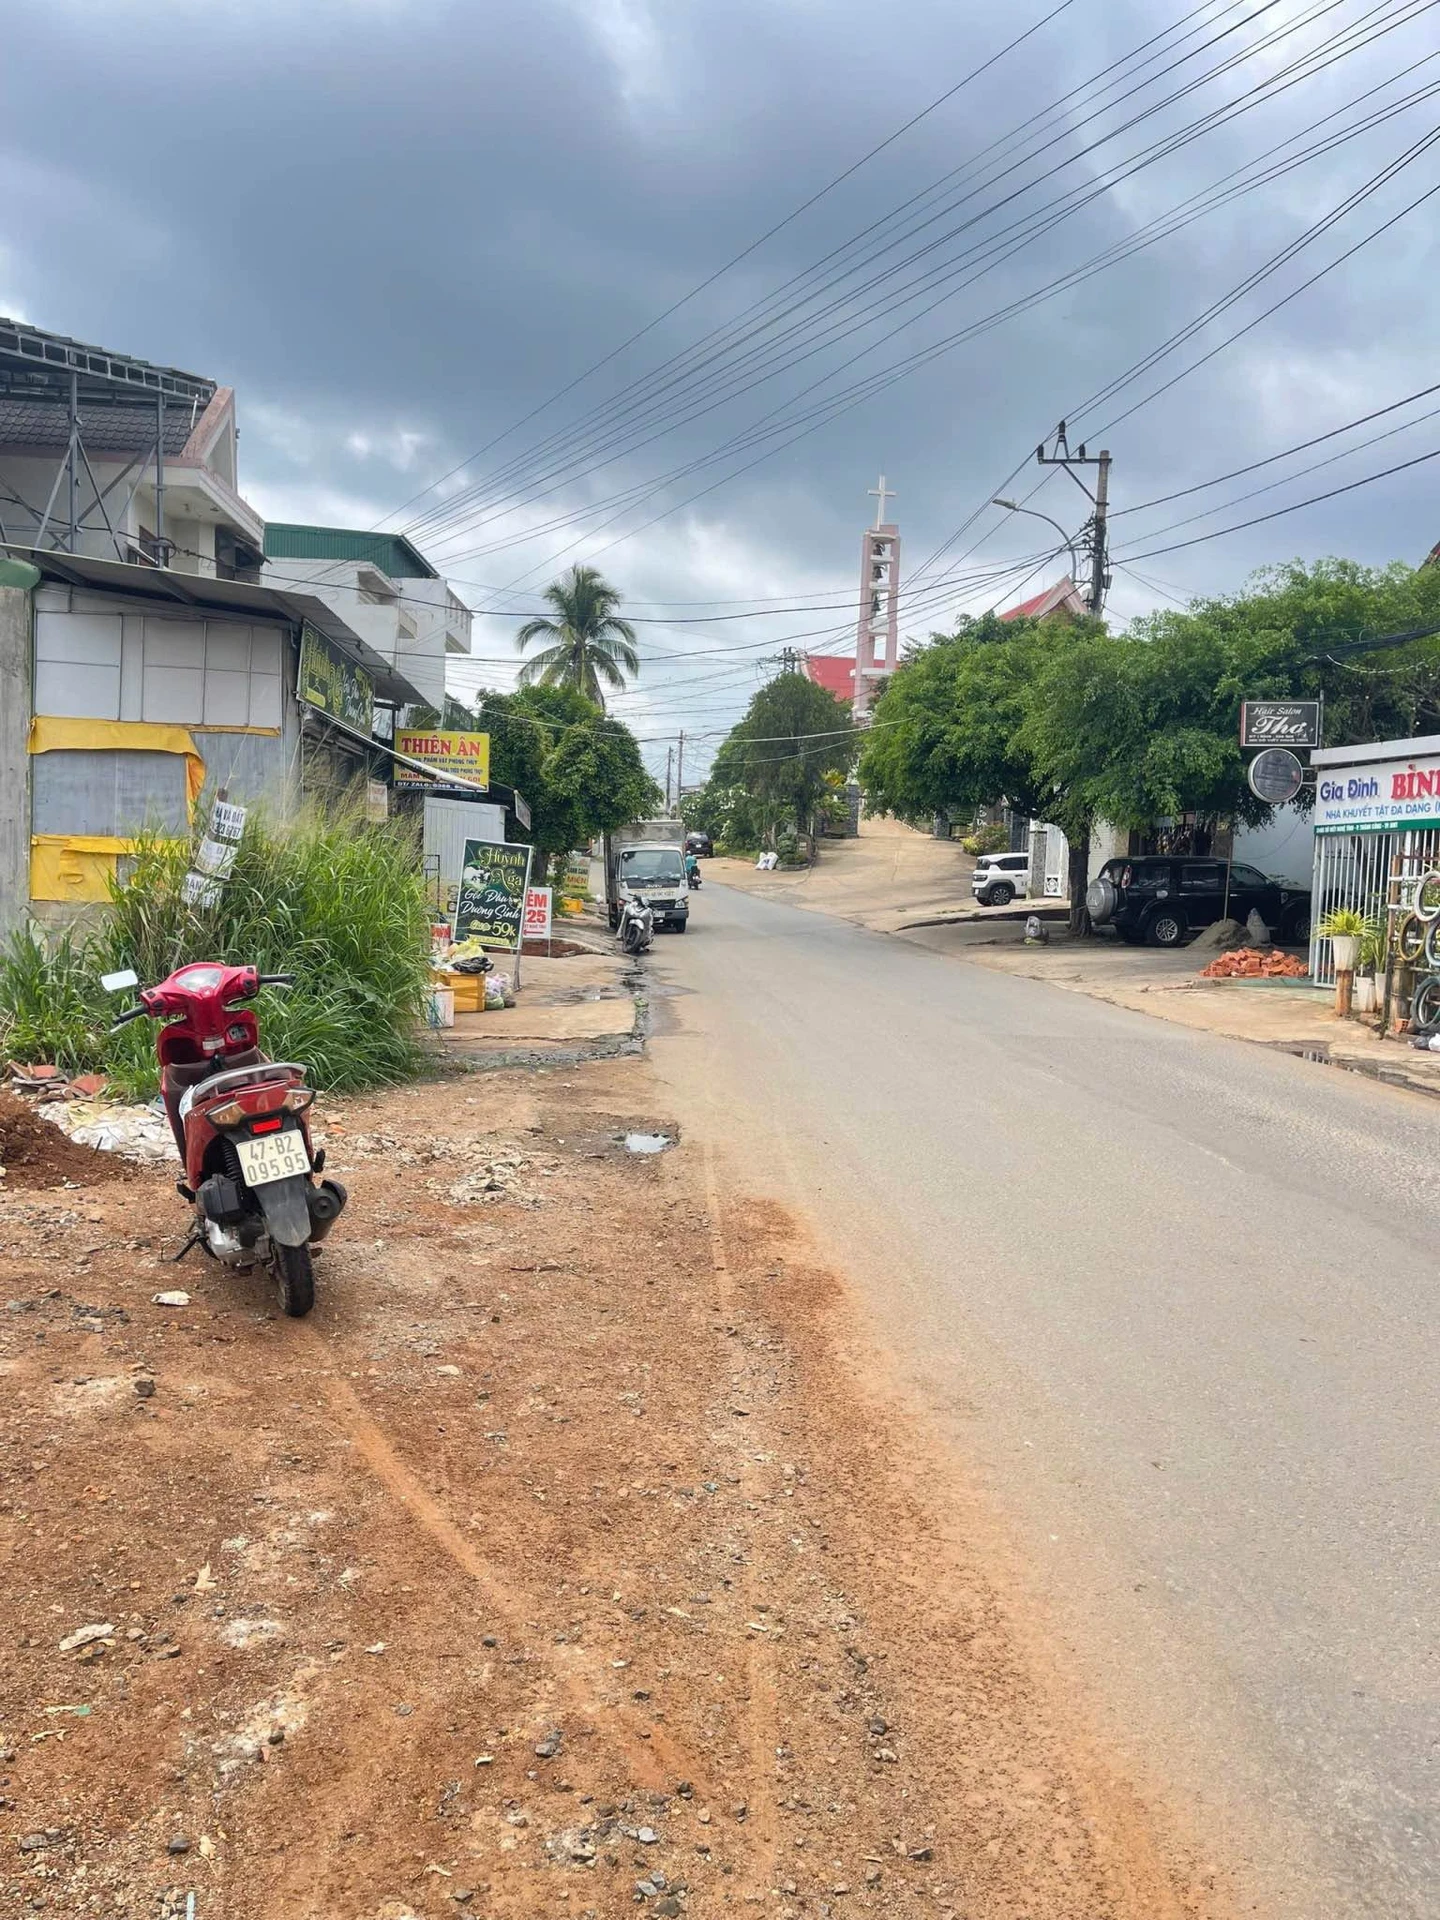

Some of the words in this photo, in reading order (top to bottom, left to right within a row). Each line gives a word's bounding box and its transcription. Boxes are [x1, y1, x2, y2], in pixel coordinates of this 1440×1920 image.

[1250, 707, 1274, 715] Hair
[1276, 707, 1302, 715] Salon
[1251, 715, 1308, 735] Thơ
[401, 735, 452, 756] THIÊN
[457, 736, 481, 757] ÂN
[1320, 781, 1343, 800] Gia
[1342, 804, 1372, 818] KHUYẾT
[1375, 804, 1389, 818] TẬT
[1390, 805, 1403, 816] ĐA
[1405, 803, 1431, 817] DẠNG
[494, 904, 521, 920] Sinh
[491, 921, 516, 937] 59k
[247, 1152, 306, 1182] 095.95
